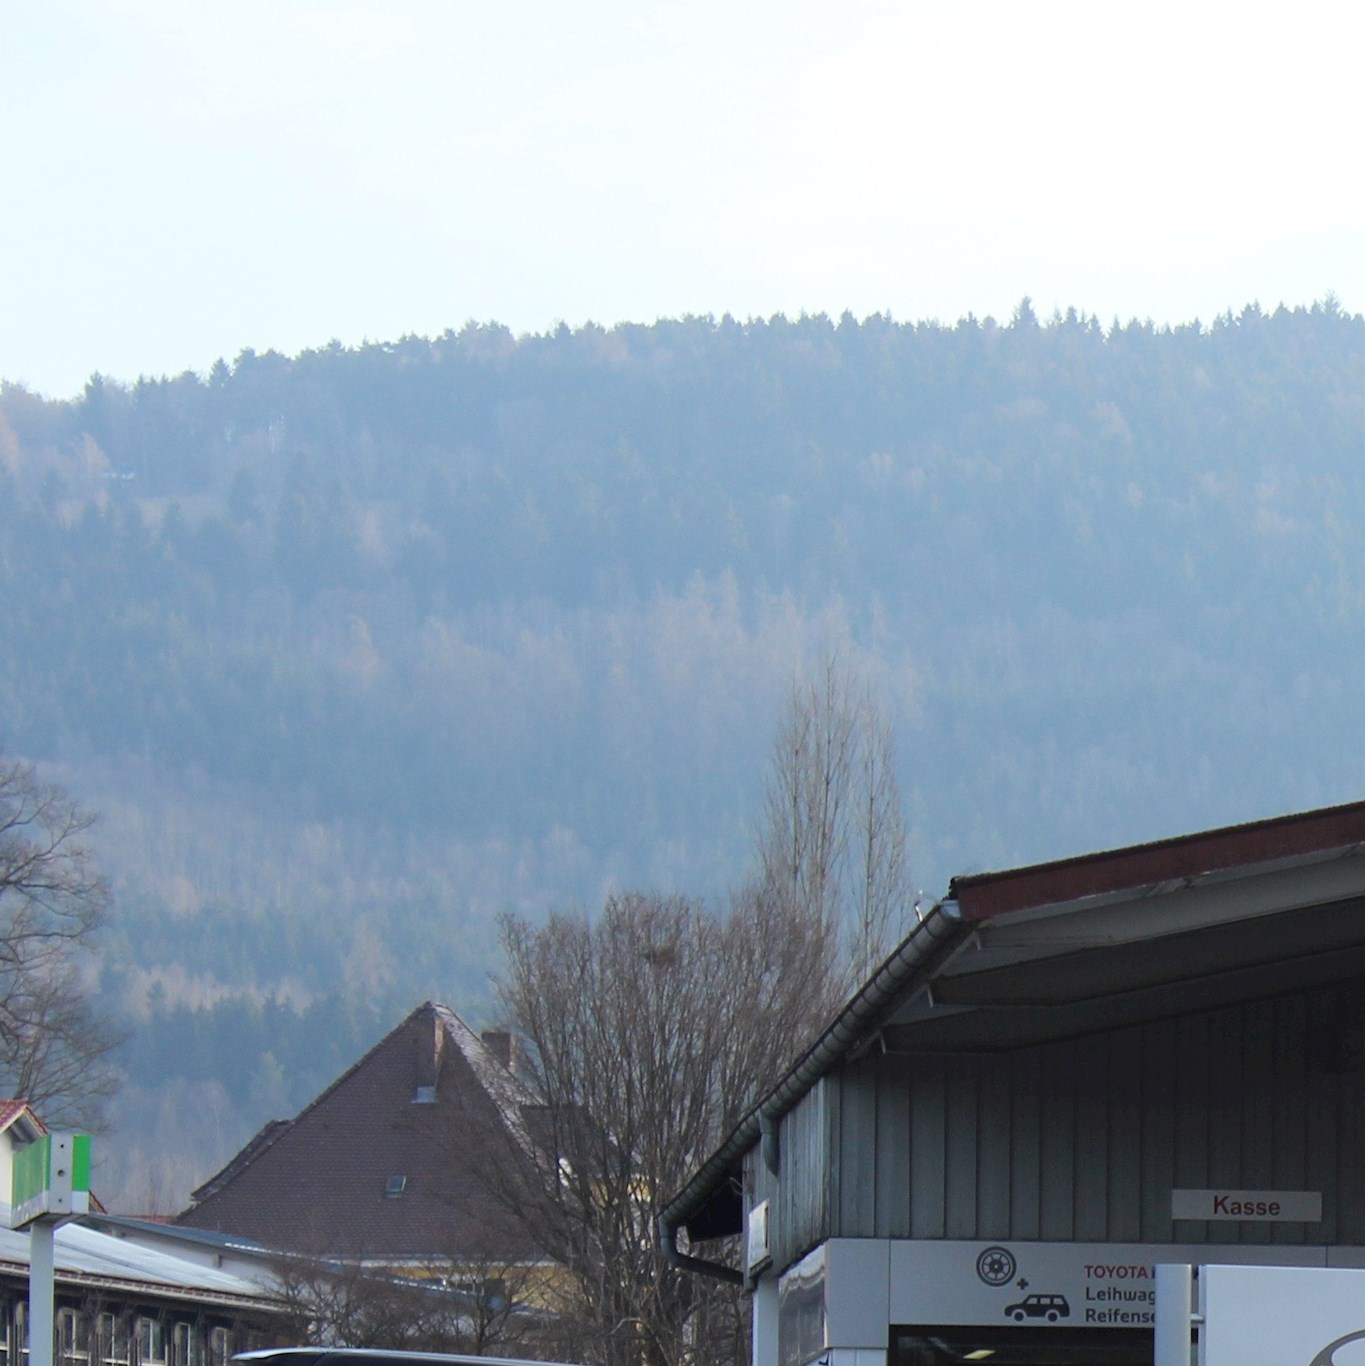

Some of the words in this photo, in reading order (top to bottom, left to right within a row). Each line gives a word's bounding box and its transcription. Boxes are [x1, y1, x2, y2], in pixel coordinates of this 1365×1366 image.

[1213, 1196, 1281, 1217] Kasse
[1084, 1265, 1148, 1279] TOYOTA
[1085, 1287, 1155, 1305] Leihwag
[1085, 1308, 1155, 1323] Reifens
